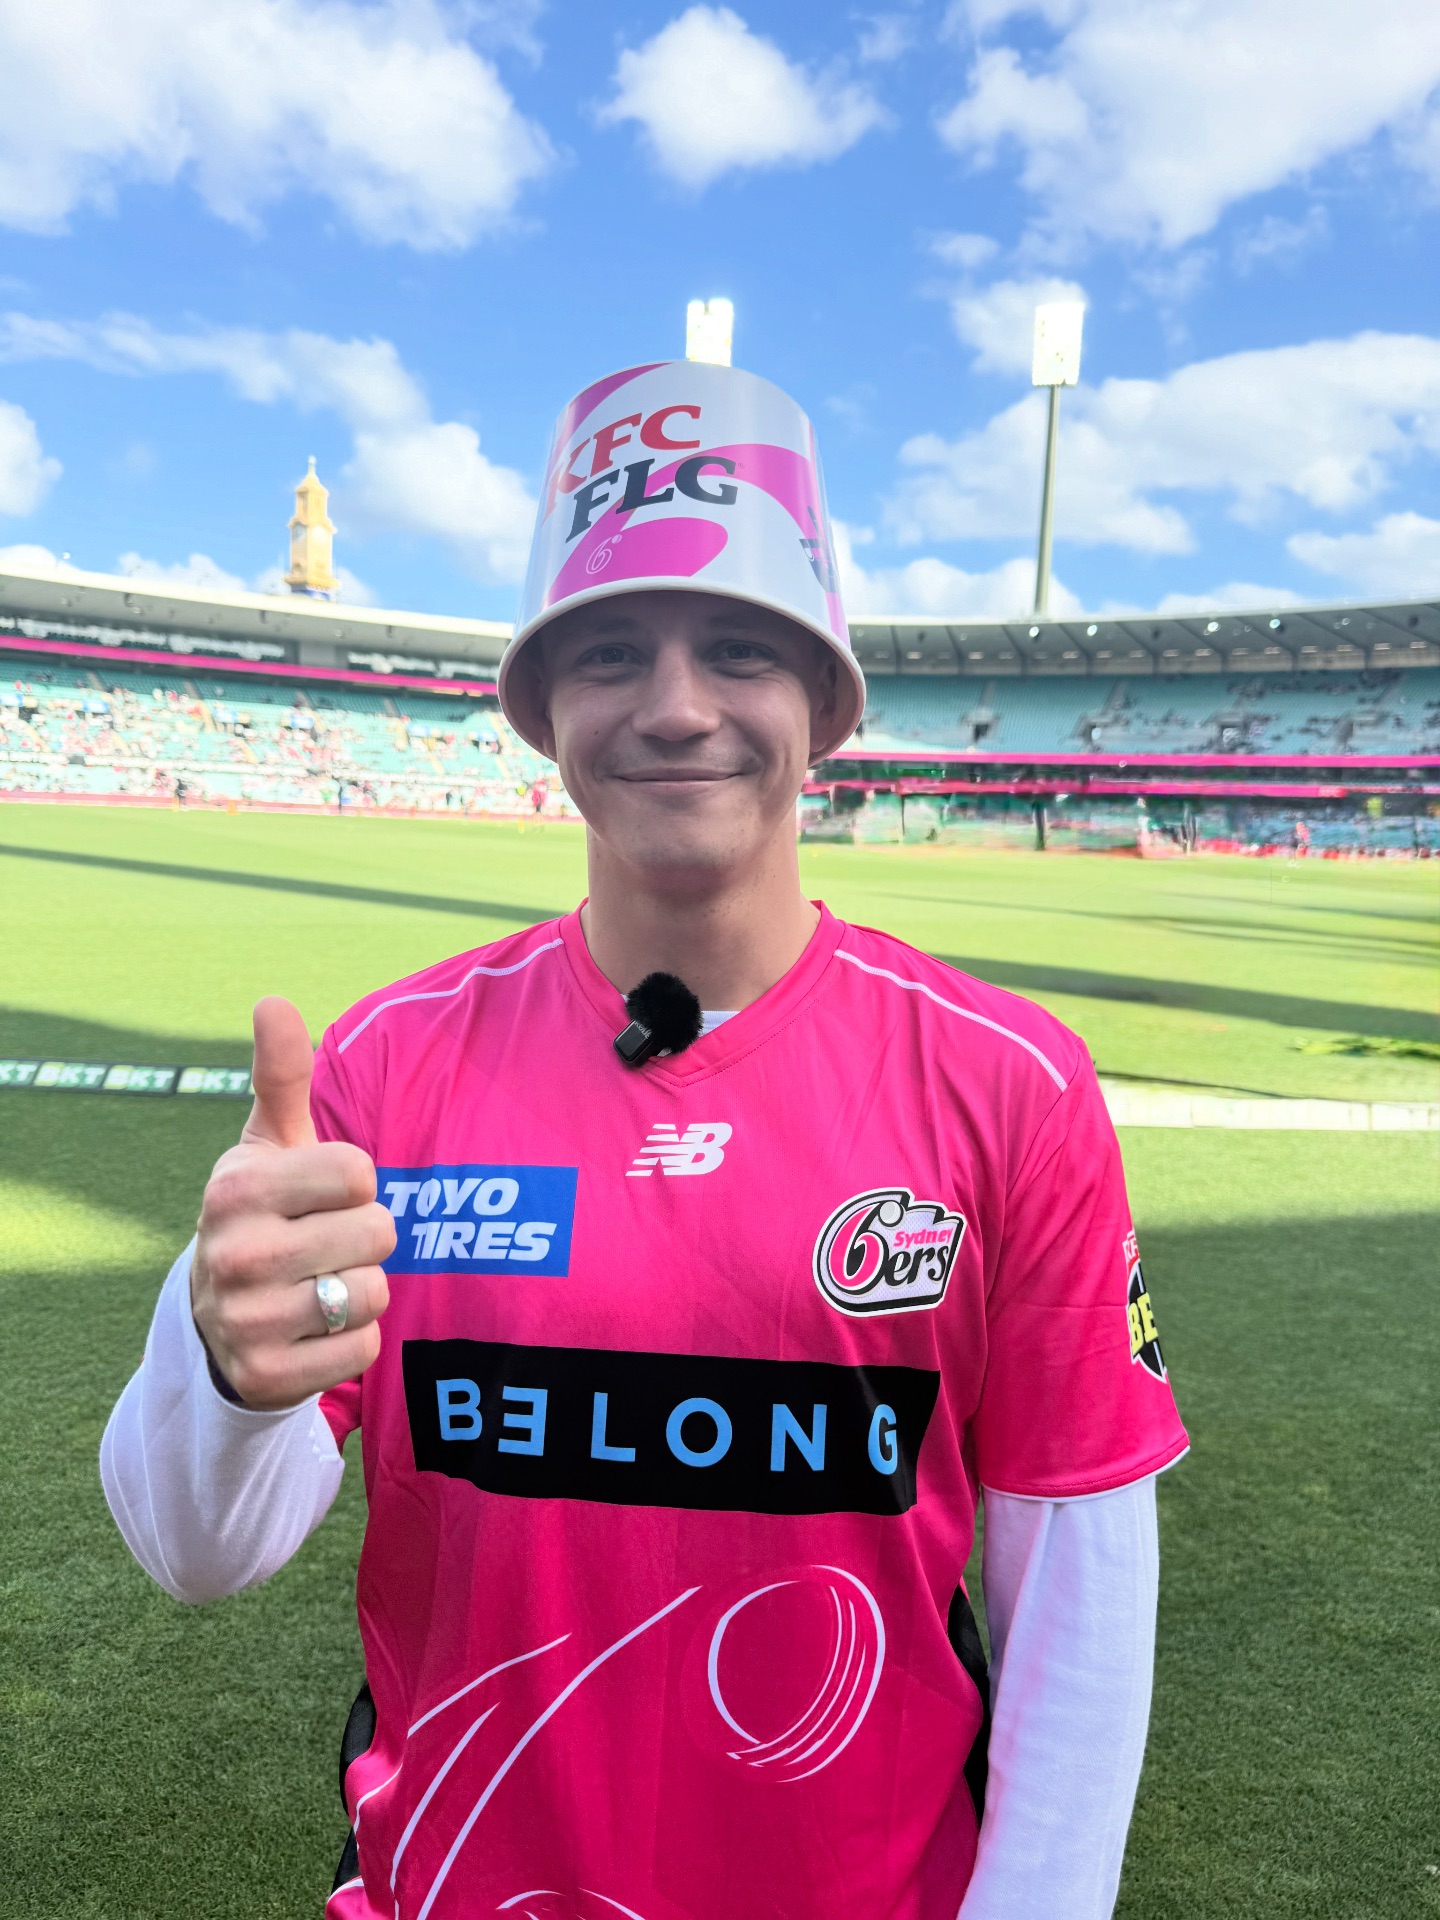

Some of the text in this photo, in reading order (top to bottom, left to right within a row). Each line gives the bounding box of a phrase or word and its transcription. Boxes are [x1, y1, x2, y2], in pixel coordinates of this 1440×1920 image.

[542, 404, 702, 526] KFC
[565, 456, 738, 543] FLG
[42, 1064, 105, 1084] BKT
[109, 1068, 175, 1088] BKT
[184, 1070, 250, 1090] BKT
[383, 1177, 519, 1217] TOYO
[411, 1222, 556, 1261] TIRES
[893, 1227, 953, 1248] Sydney
